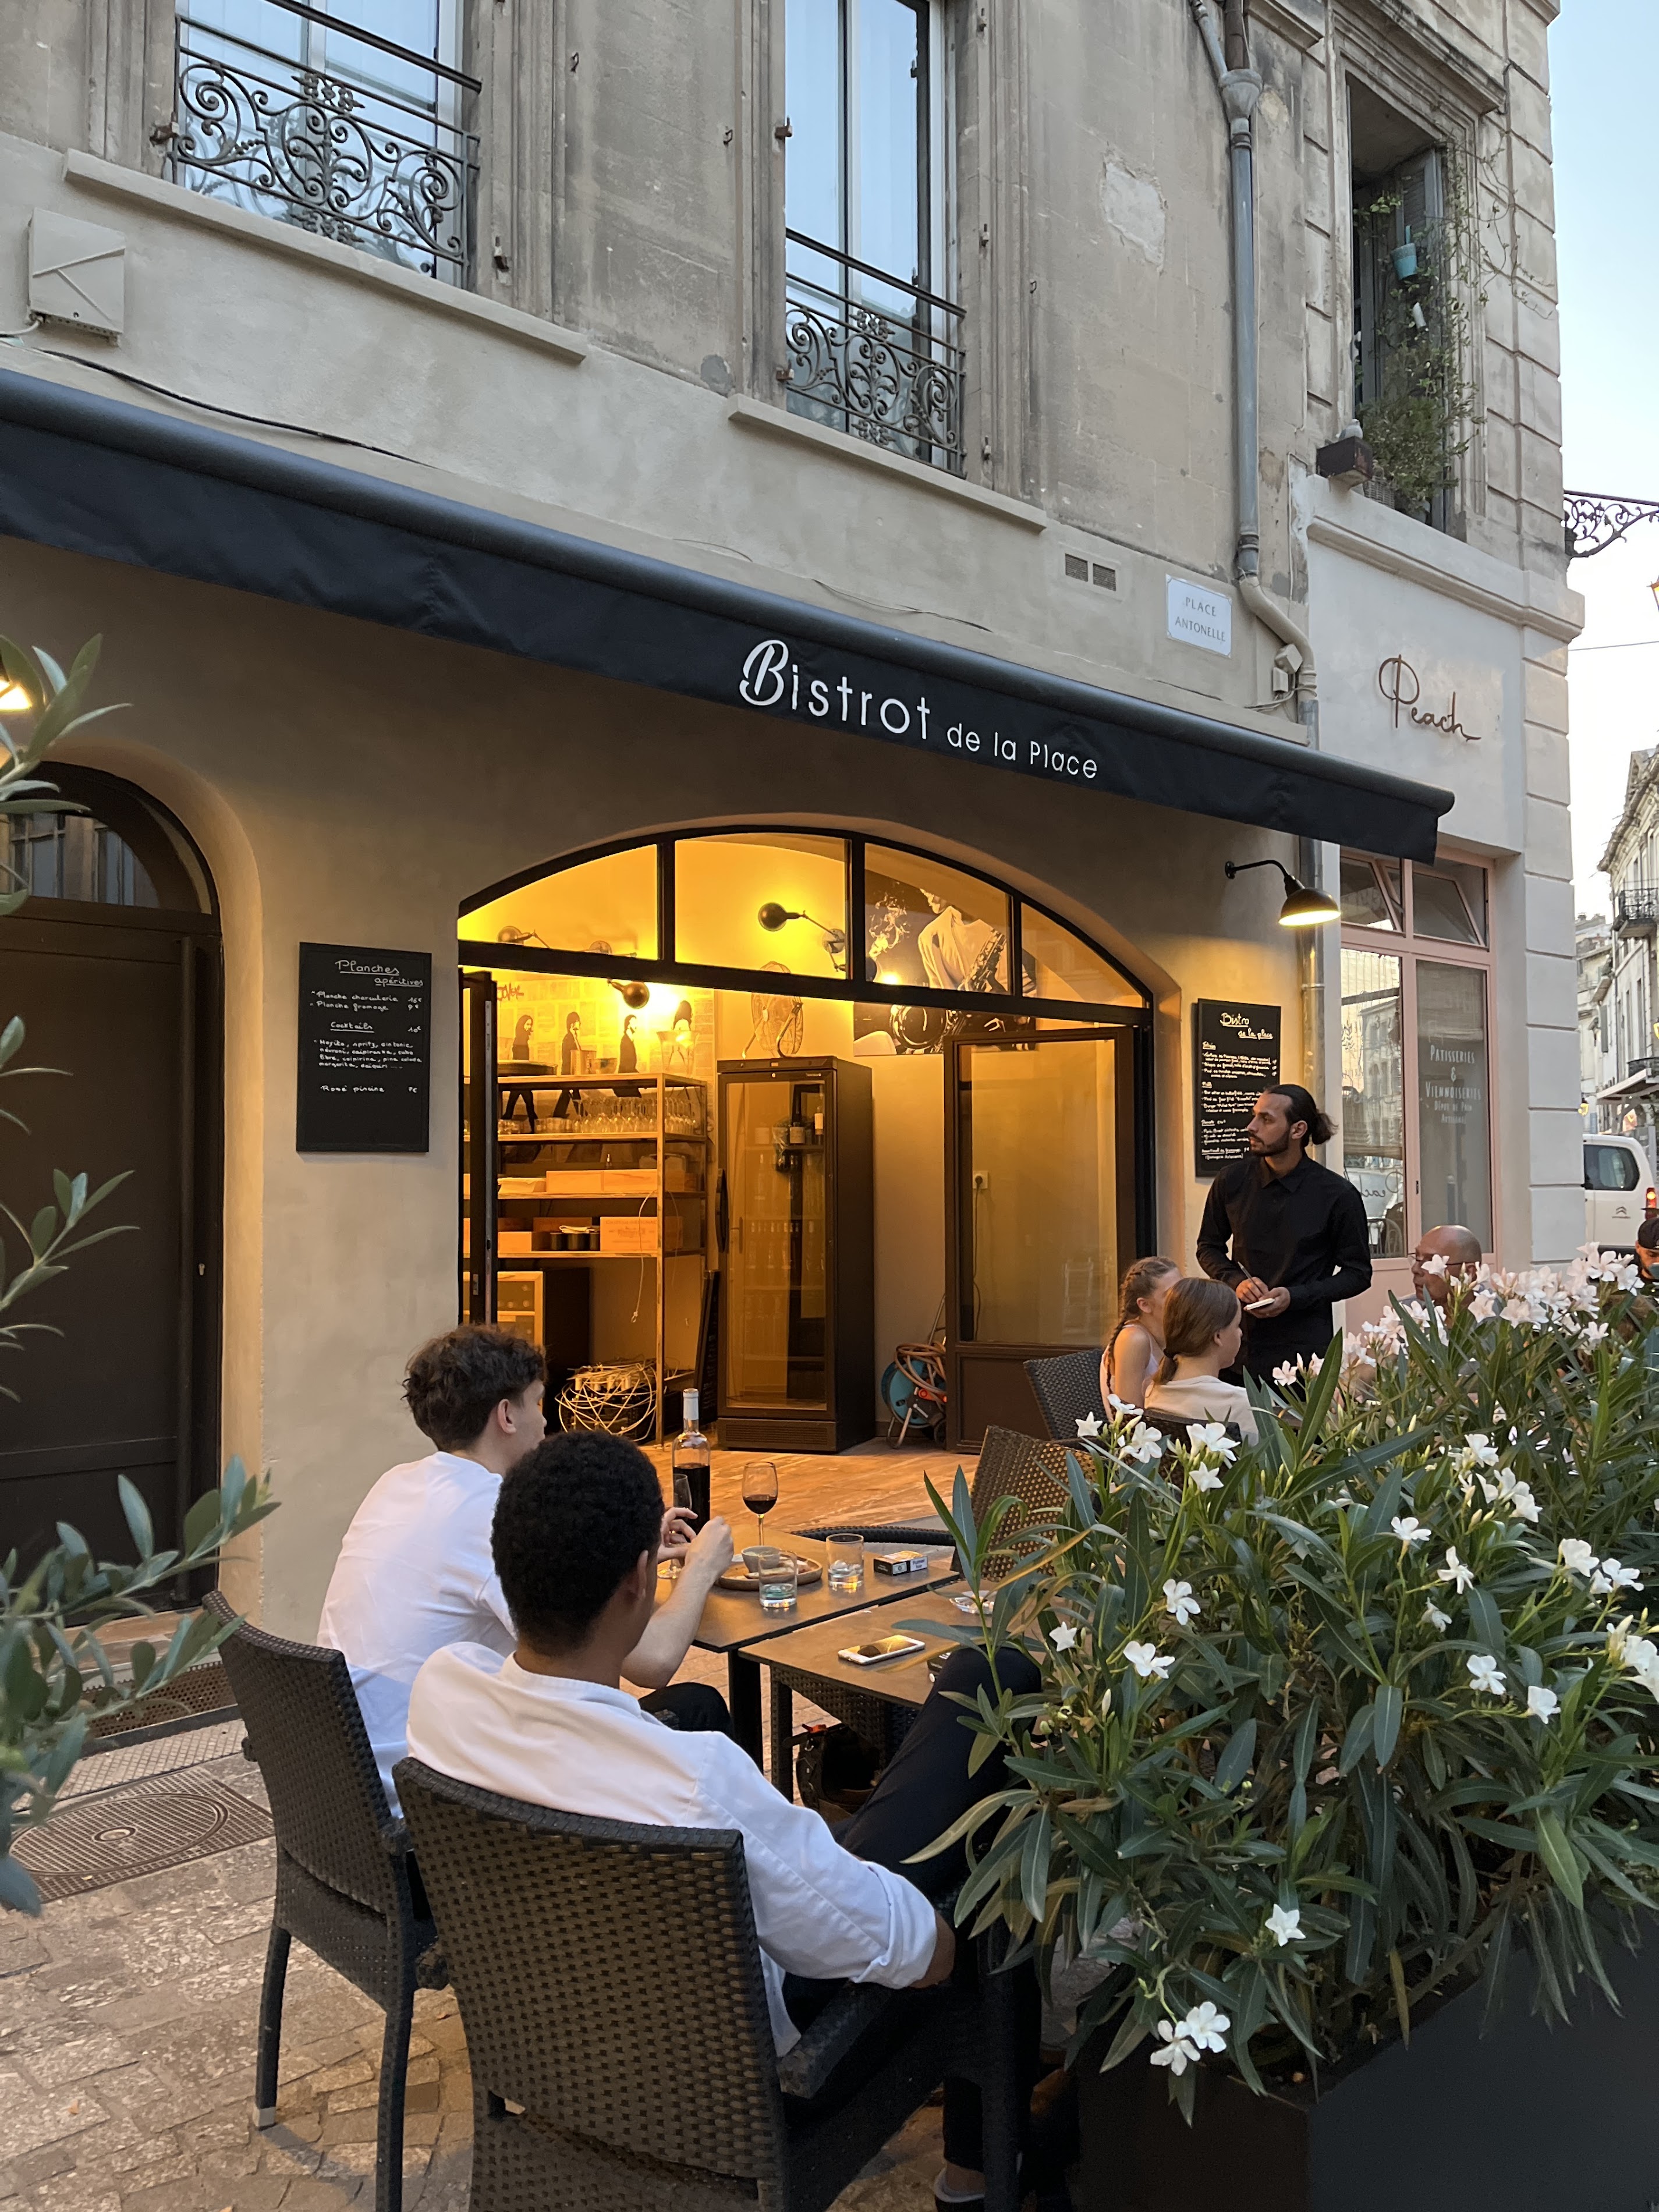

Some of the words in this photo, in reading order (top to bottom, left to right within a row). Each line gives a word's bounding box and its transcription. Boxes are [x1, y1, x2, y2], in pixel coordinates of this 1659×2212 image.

[1186, 597, 1217, 617] PLACE
[1175, 616, 1226, 642] ANTONELLE
[1379, 654, 1481, 742] Peach
[739, 639, 930, 740] Bistrot
[947, 723, 980, 751] de
[994, 732, 1016, 761] la
[1030, 740, 1097, 779] Place
[335, 960, 400, 974] Planches
[374, 977, 423, 987] apéritives
[316, 991, 348, 999] Planche
[316, 1000, 349, 1009] Planche
[353, 1003, 389, 1012] fromage
[331, 1021, 373, 1030] Cocktails
[1220, 1013, 1250, 1025] Bistro
[1248, 1027, 1256, 1037] la
[1257, 1029, 1273, 1040] place
[1430, 1044, 1475, 1064] PATISSERIES
[1426, 1082, 1481, 1100] VIENNOISERIES
